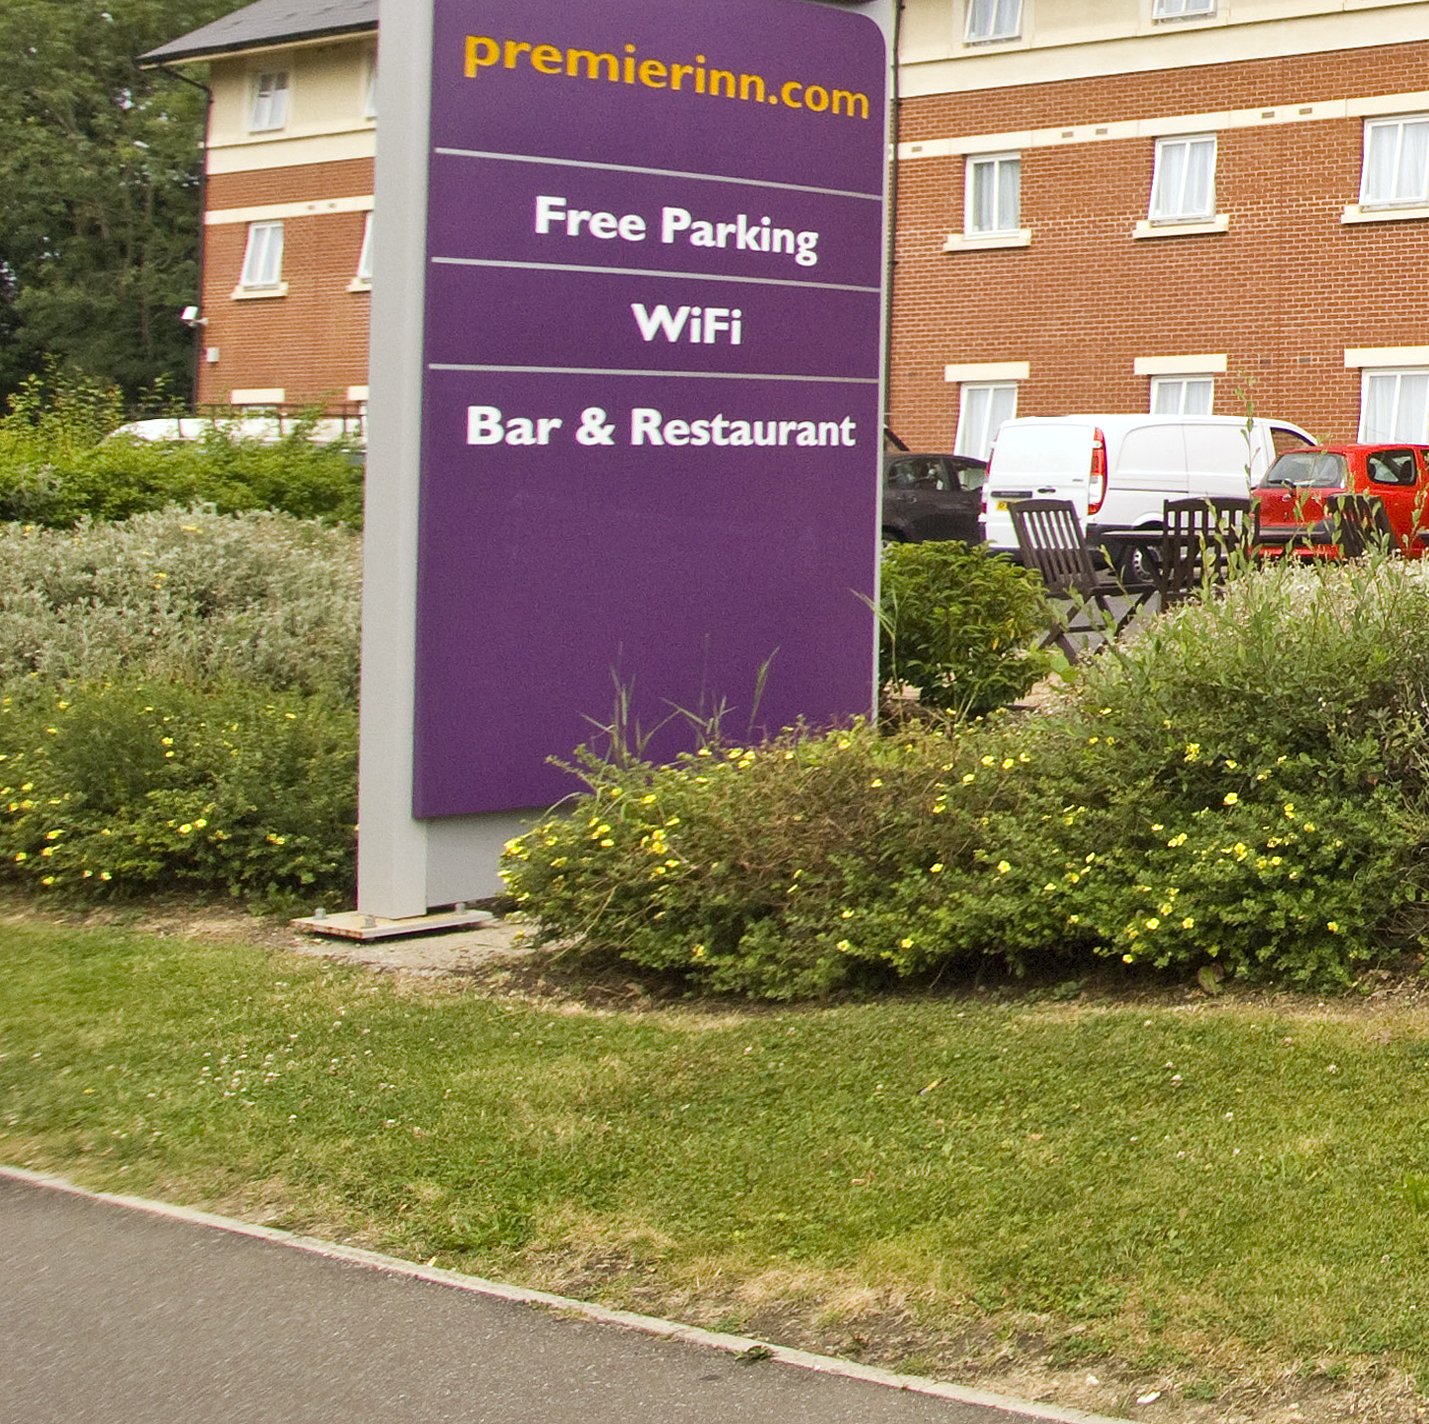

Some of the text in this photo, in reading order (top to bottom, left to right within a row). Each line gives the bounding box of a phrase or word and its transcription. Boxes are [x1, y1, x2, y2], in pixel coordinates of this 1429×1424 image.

[464, 35, 869, 120] premierinn.com
[535, 195, 819, 267] Free Parking
[631, 303, 742, 345] WiFi
[467, 405, 856, 447] Bar & Restaurant
